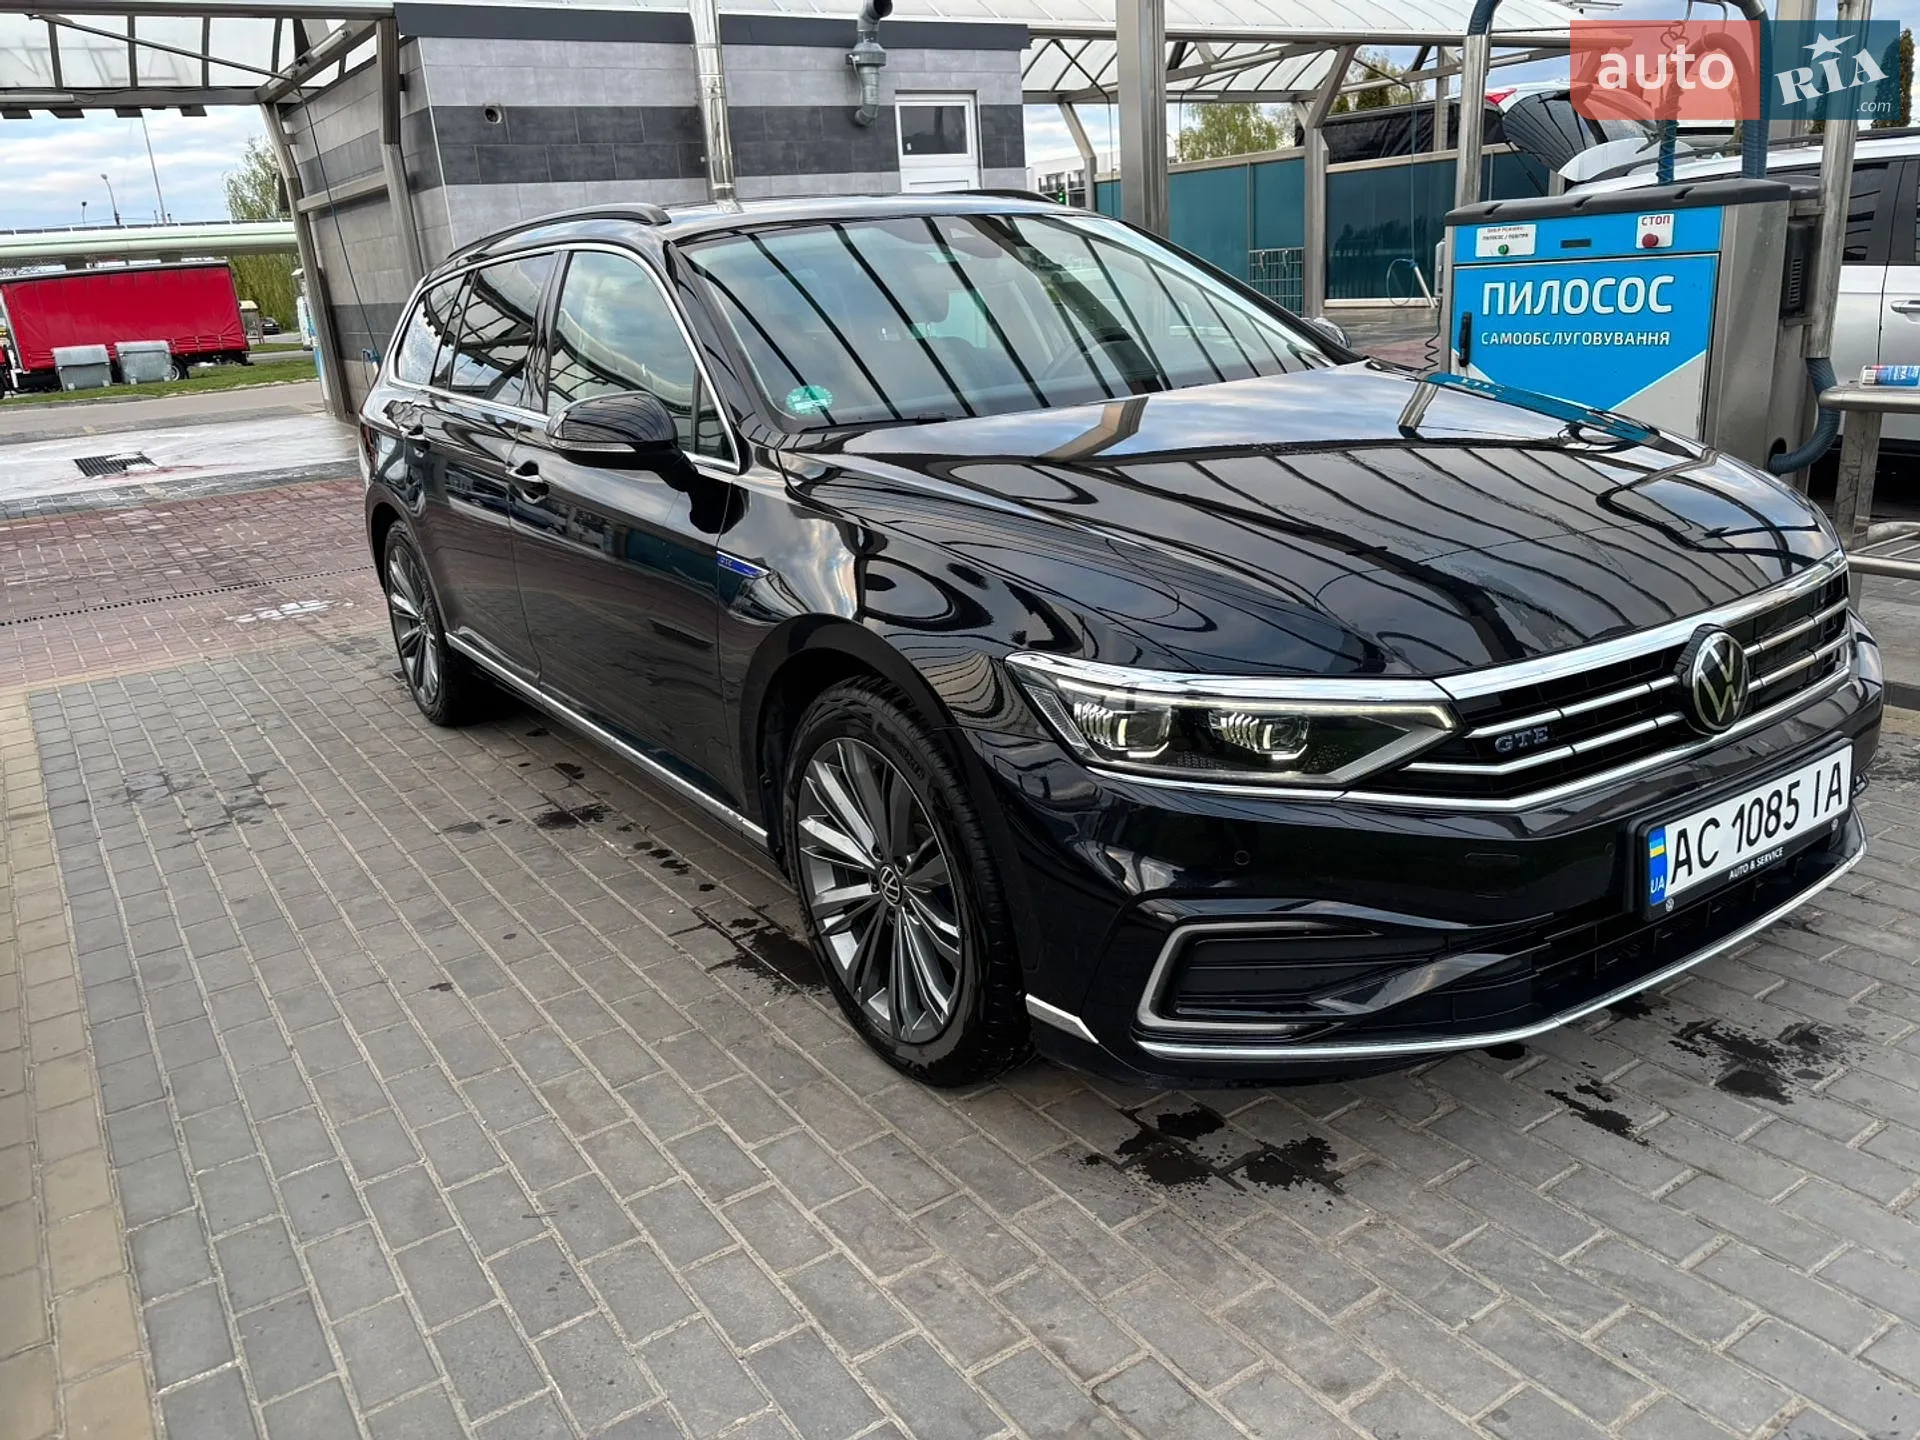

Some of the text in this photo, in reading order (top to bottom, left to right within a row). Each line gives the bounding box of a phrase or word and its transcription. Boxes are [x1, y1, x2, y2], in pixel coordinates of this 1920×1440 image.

[1641, 215, 1671, 226] СТОП
[1482, 275, 1676, 315] ПИЛОСОС
[1481, 331, 1671, 346] САМООБСЛУГОВУВАННЯ
[1495, 726, 1548, 753] GTE
[1670, 761, 1843, 885] AC 1085 IA
[1728, 863, 1750, 881] AUTO
[1756, 846, 1785, 866] SERVICE
[1650, 875, 1666, 893] UA
